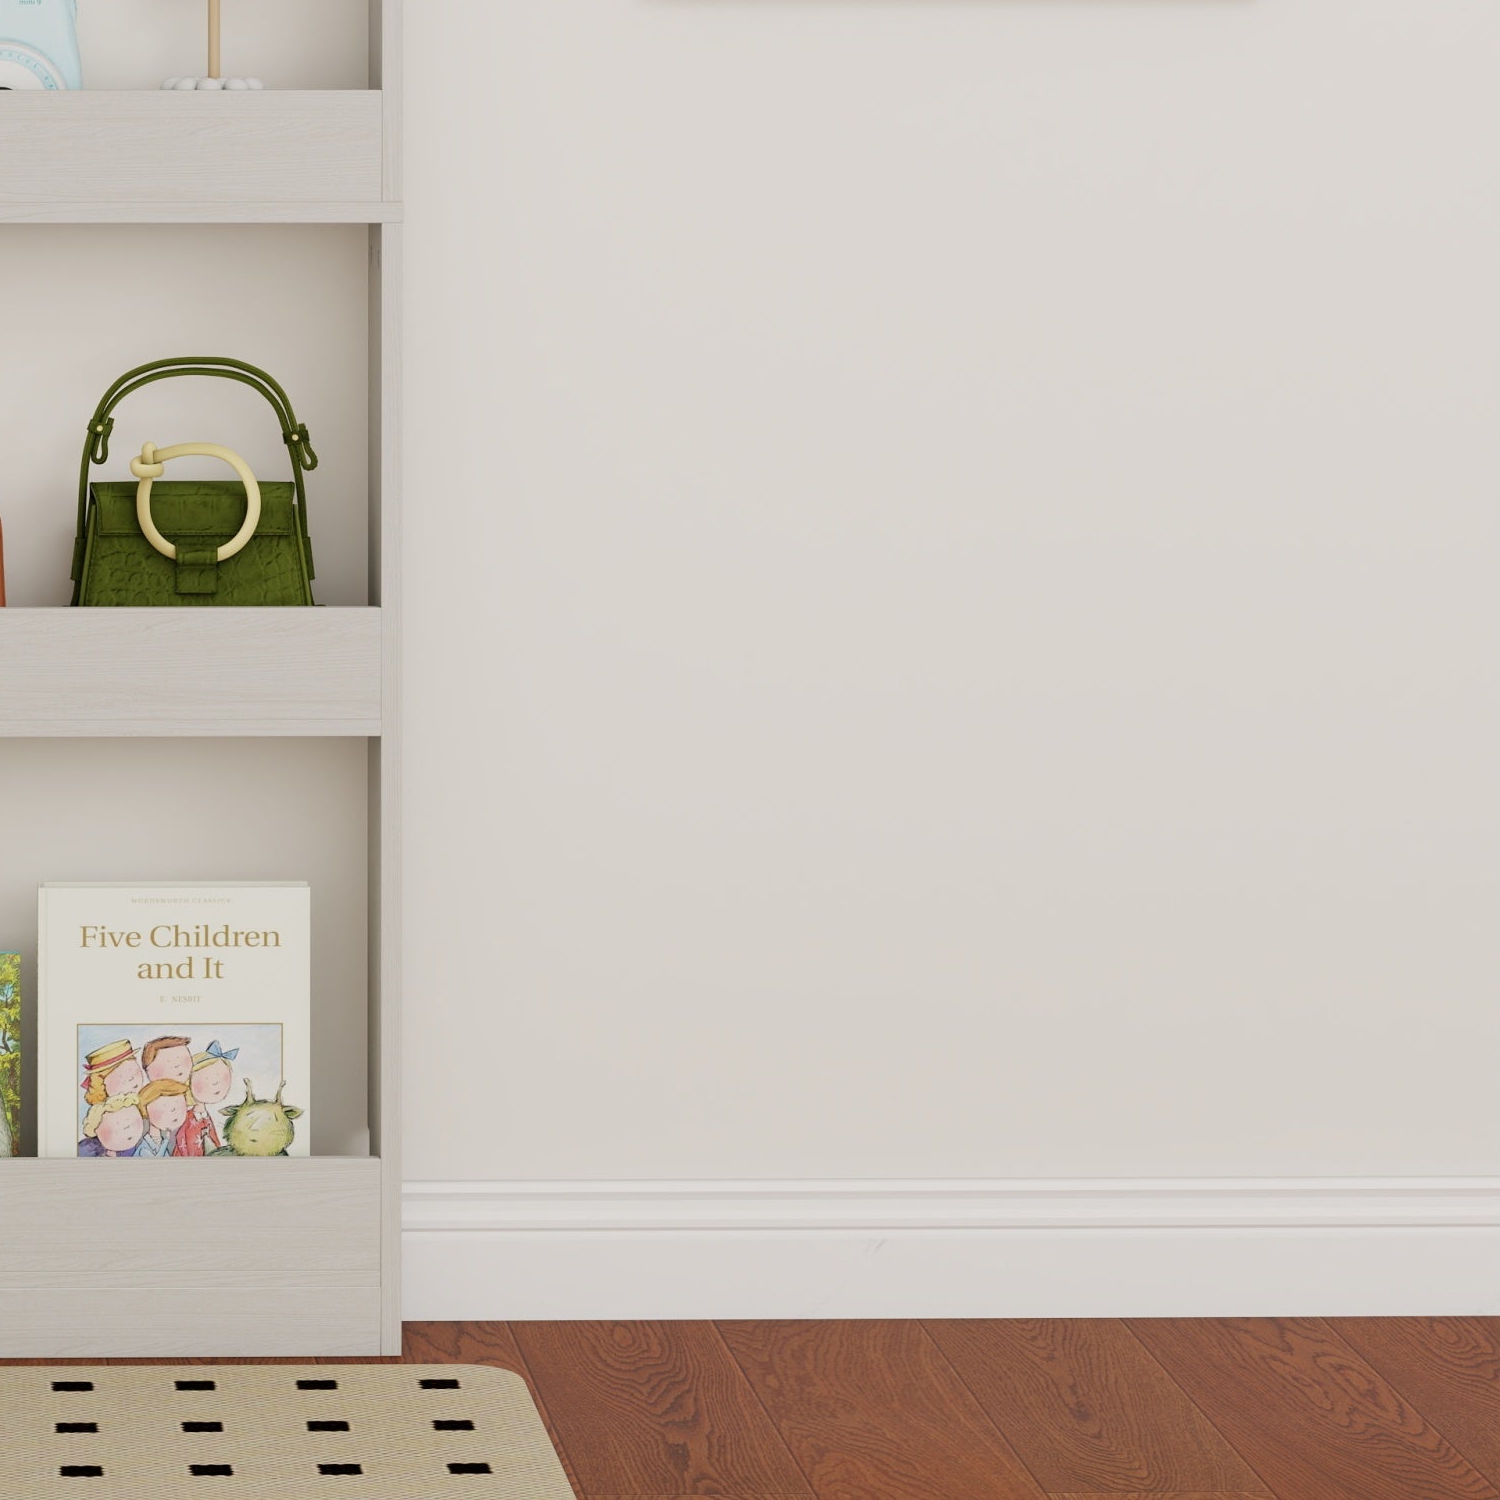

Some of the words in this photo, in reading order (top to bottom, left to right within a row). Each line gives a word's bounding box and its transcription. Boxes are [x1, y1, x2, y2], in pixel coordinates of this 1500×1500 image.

[79, 925, 142, 948] Five
[150, 924, 282, 948] Children
[137, 956, 195, 979] and
[202, 957, 225, 979] It
